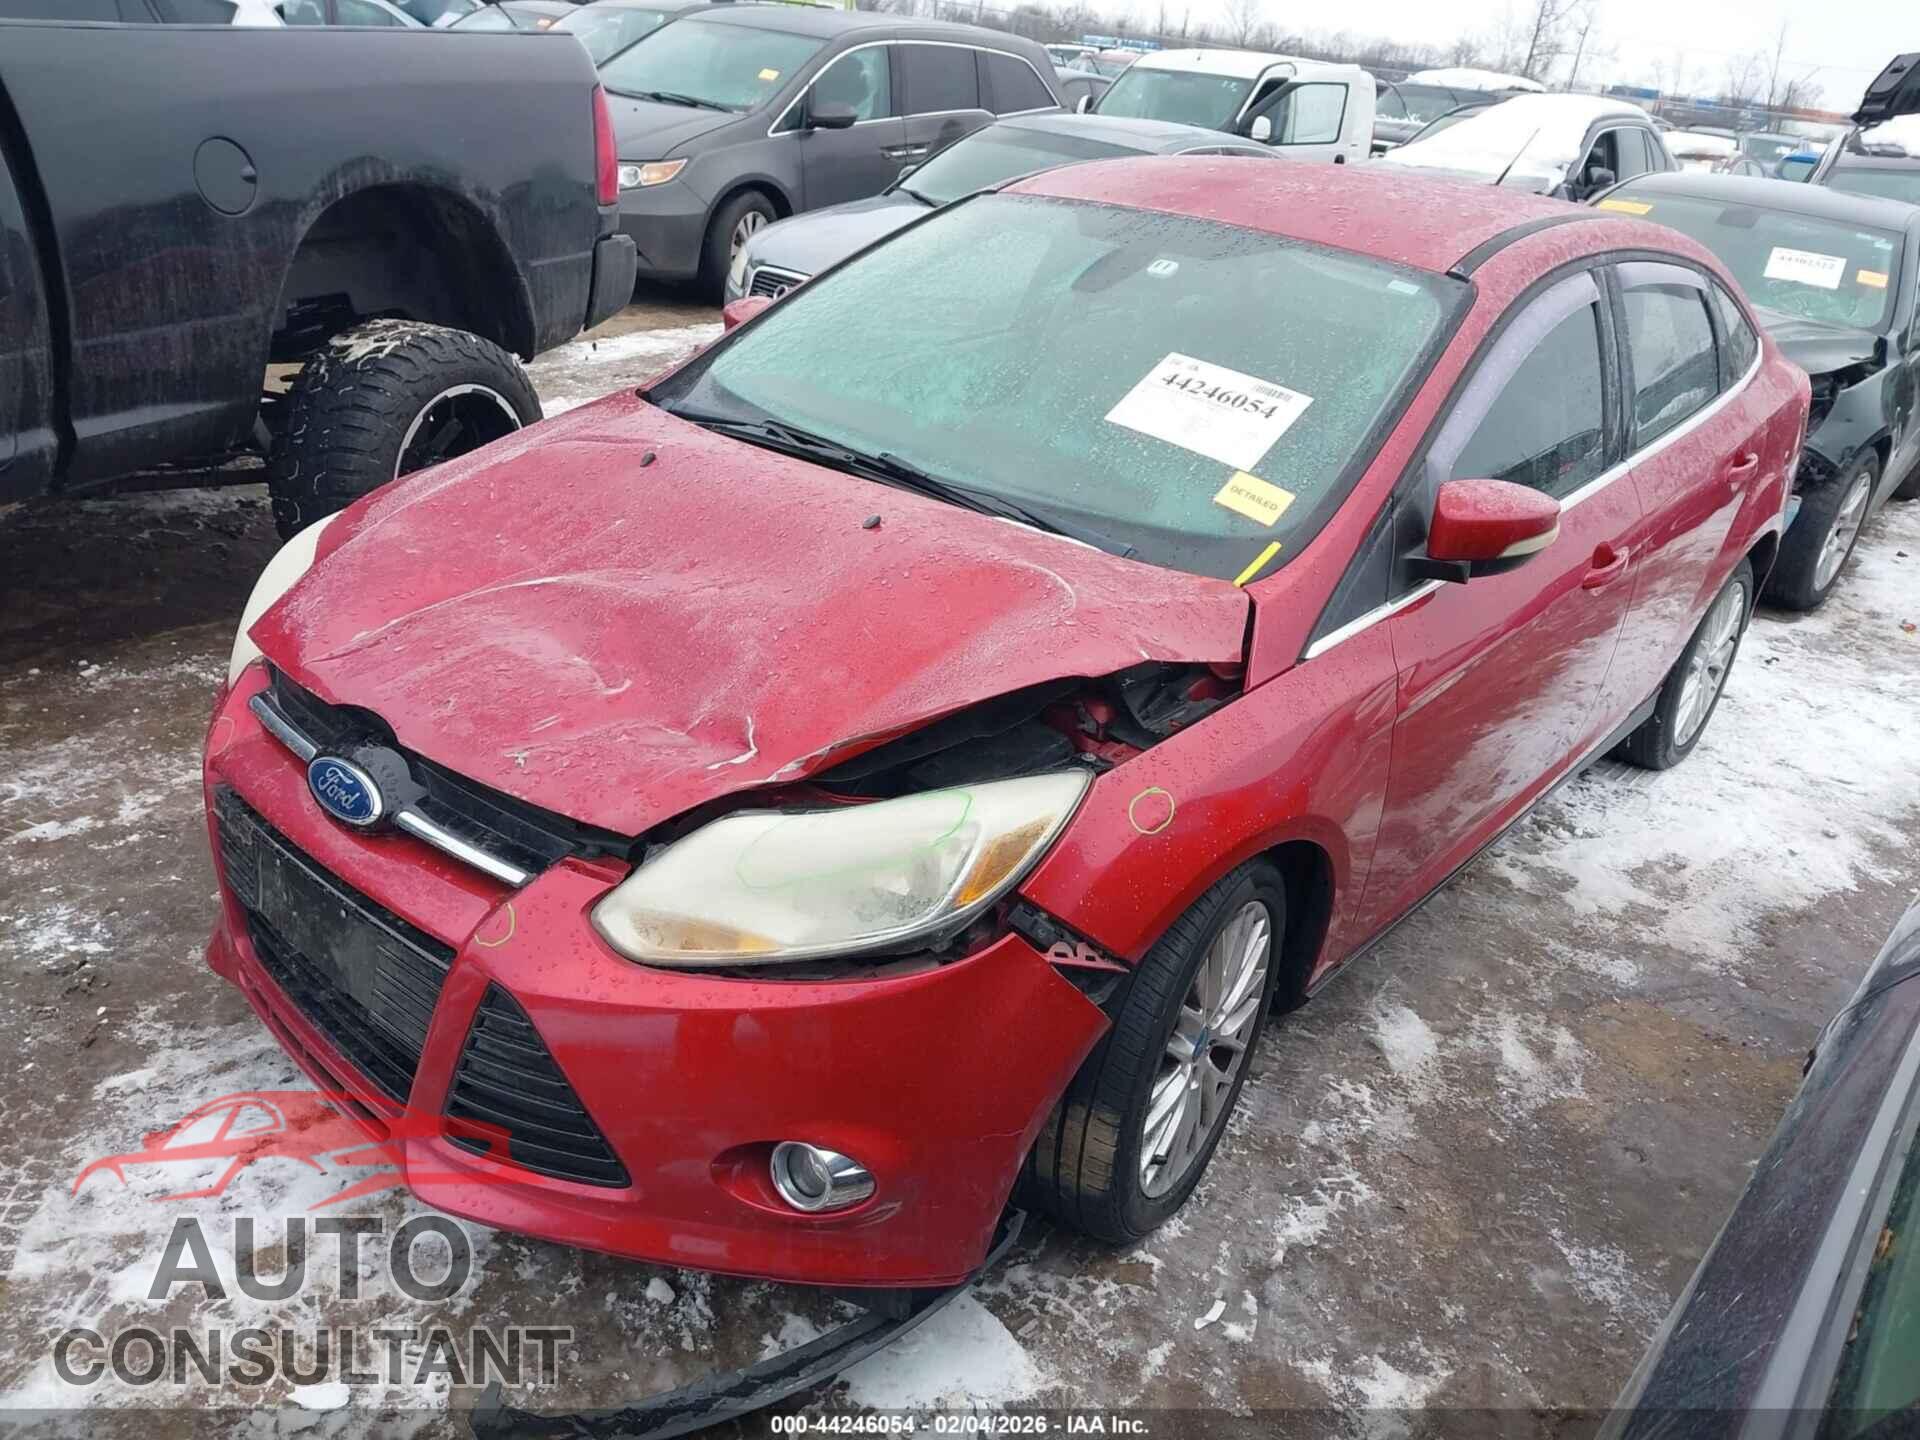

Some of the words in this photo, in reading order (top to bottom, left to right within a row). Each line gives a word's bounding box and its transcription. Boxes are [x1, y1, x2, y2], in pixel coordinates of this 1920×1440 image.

[1162, 373, 1279, 419] 44246054
[1230, 485, 1279, 512] DETAILED
[318, 766, 361, 810] Ford
